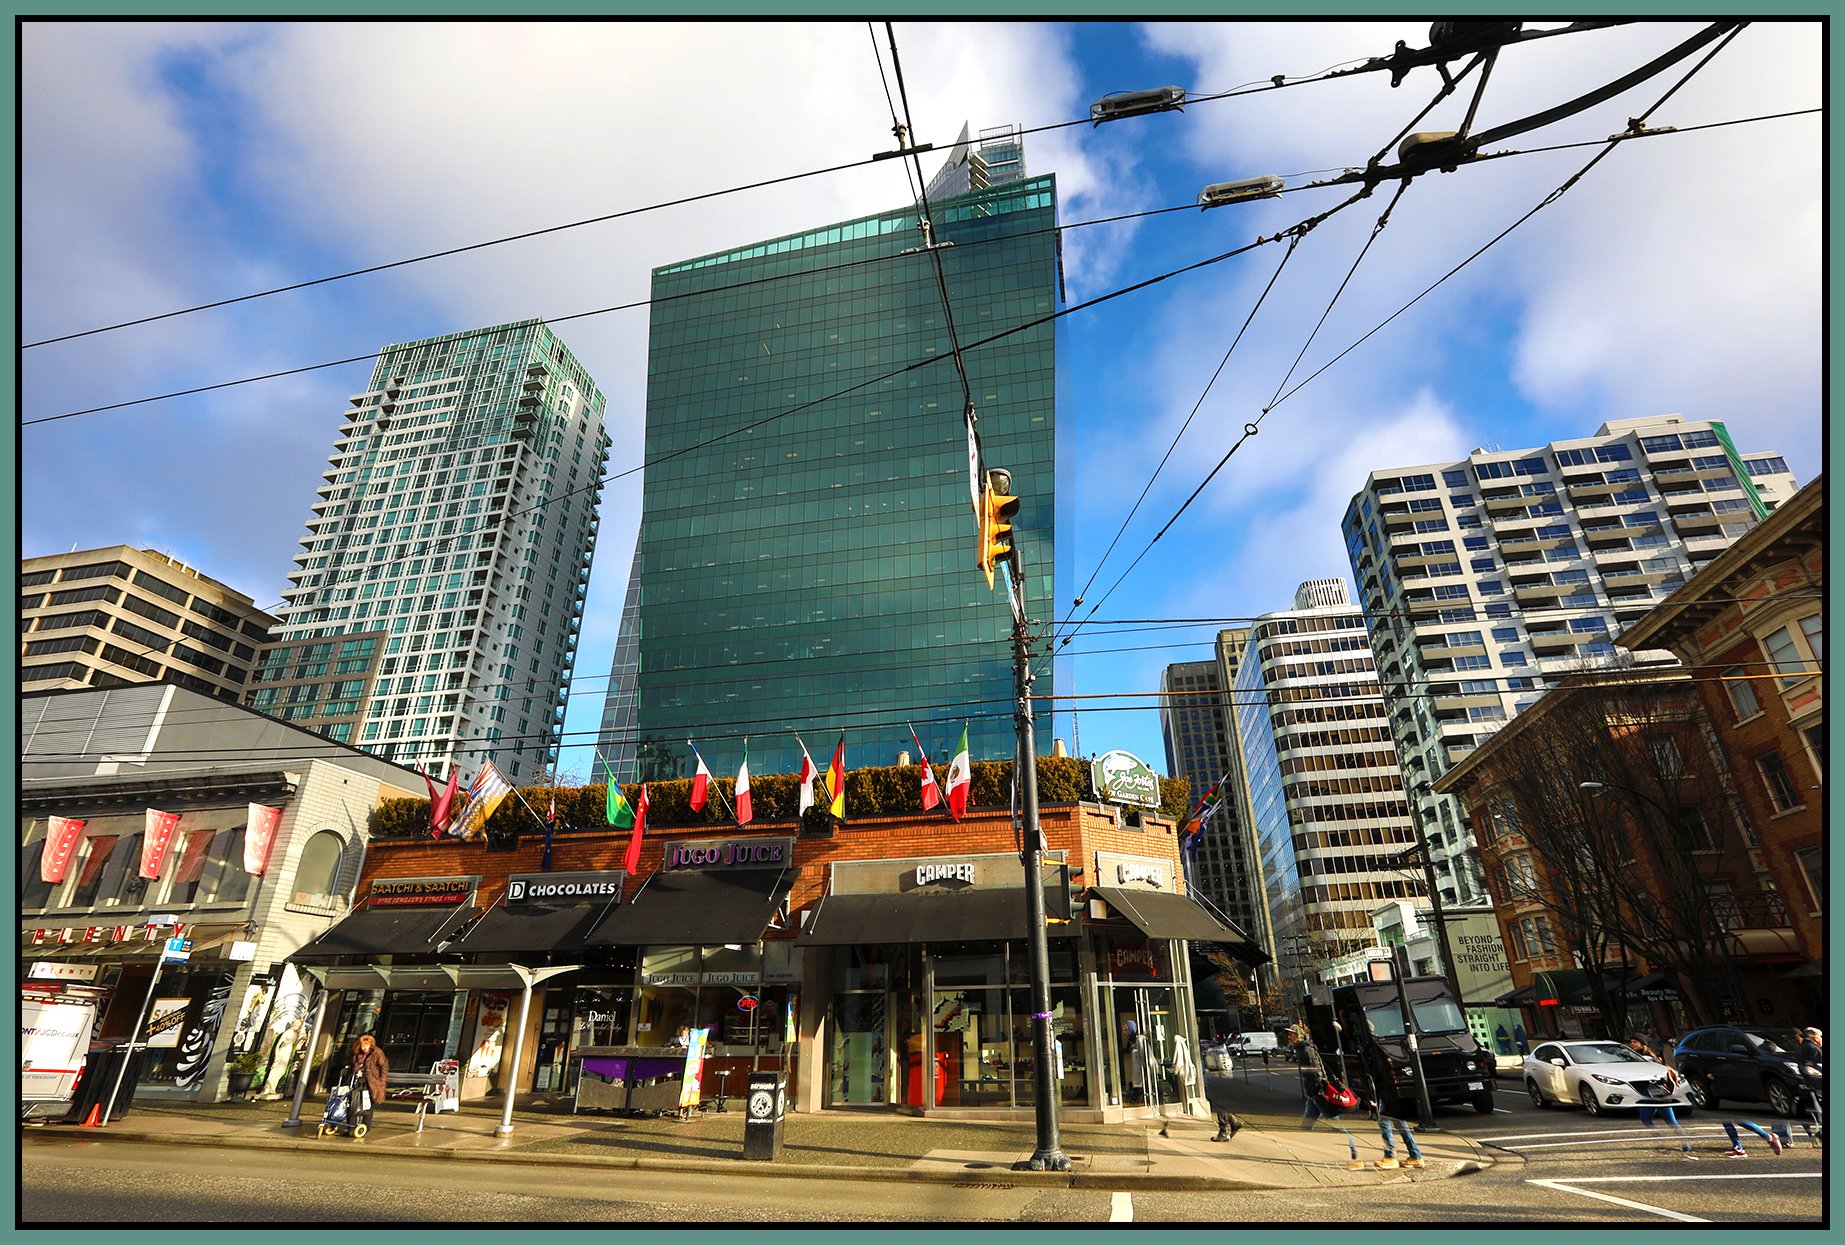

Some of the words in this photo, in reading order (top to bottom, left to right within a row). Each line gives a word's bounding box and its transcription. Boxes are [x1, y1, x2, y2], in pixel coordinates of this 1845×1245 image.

[668, 845, 721, 867] JUGO
[724, 843, 783, 865] JUICE
[916, 863, 975, 886] CAMPER
[1120, 863, 1163, 887] CAMPER
[372, 883, 413, 895] SAATCHI
[415, 882, 423, 893] &
[425, 881, 468, 893] SAATCHI
[529, 883, 615, 897] CHOCOLATES
[32, 923, 186, 944] PLENTY
[1458, 935, 1493, 945] BEYOND
[1466, 944, 1504, 953] FASHION
[1116, 949, 1154, 969] CAMPER
[1457, 954, 1500, 963] STRAIGHT
[40, 967, 94, 976] PLENTY
[1469, 963, 1490, 972] INTO
[1492, 962, 1510, 971] LIFE
[648, 973, 669, 983] JUGO
[669, 973, 695, 983] JUICE
[707, 973, 729, 983] JUGO
[731, 973, 756, 983] JUICE
